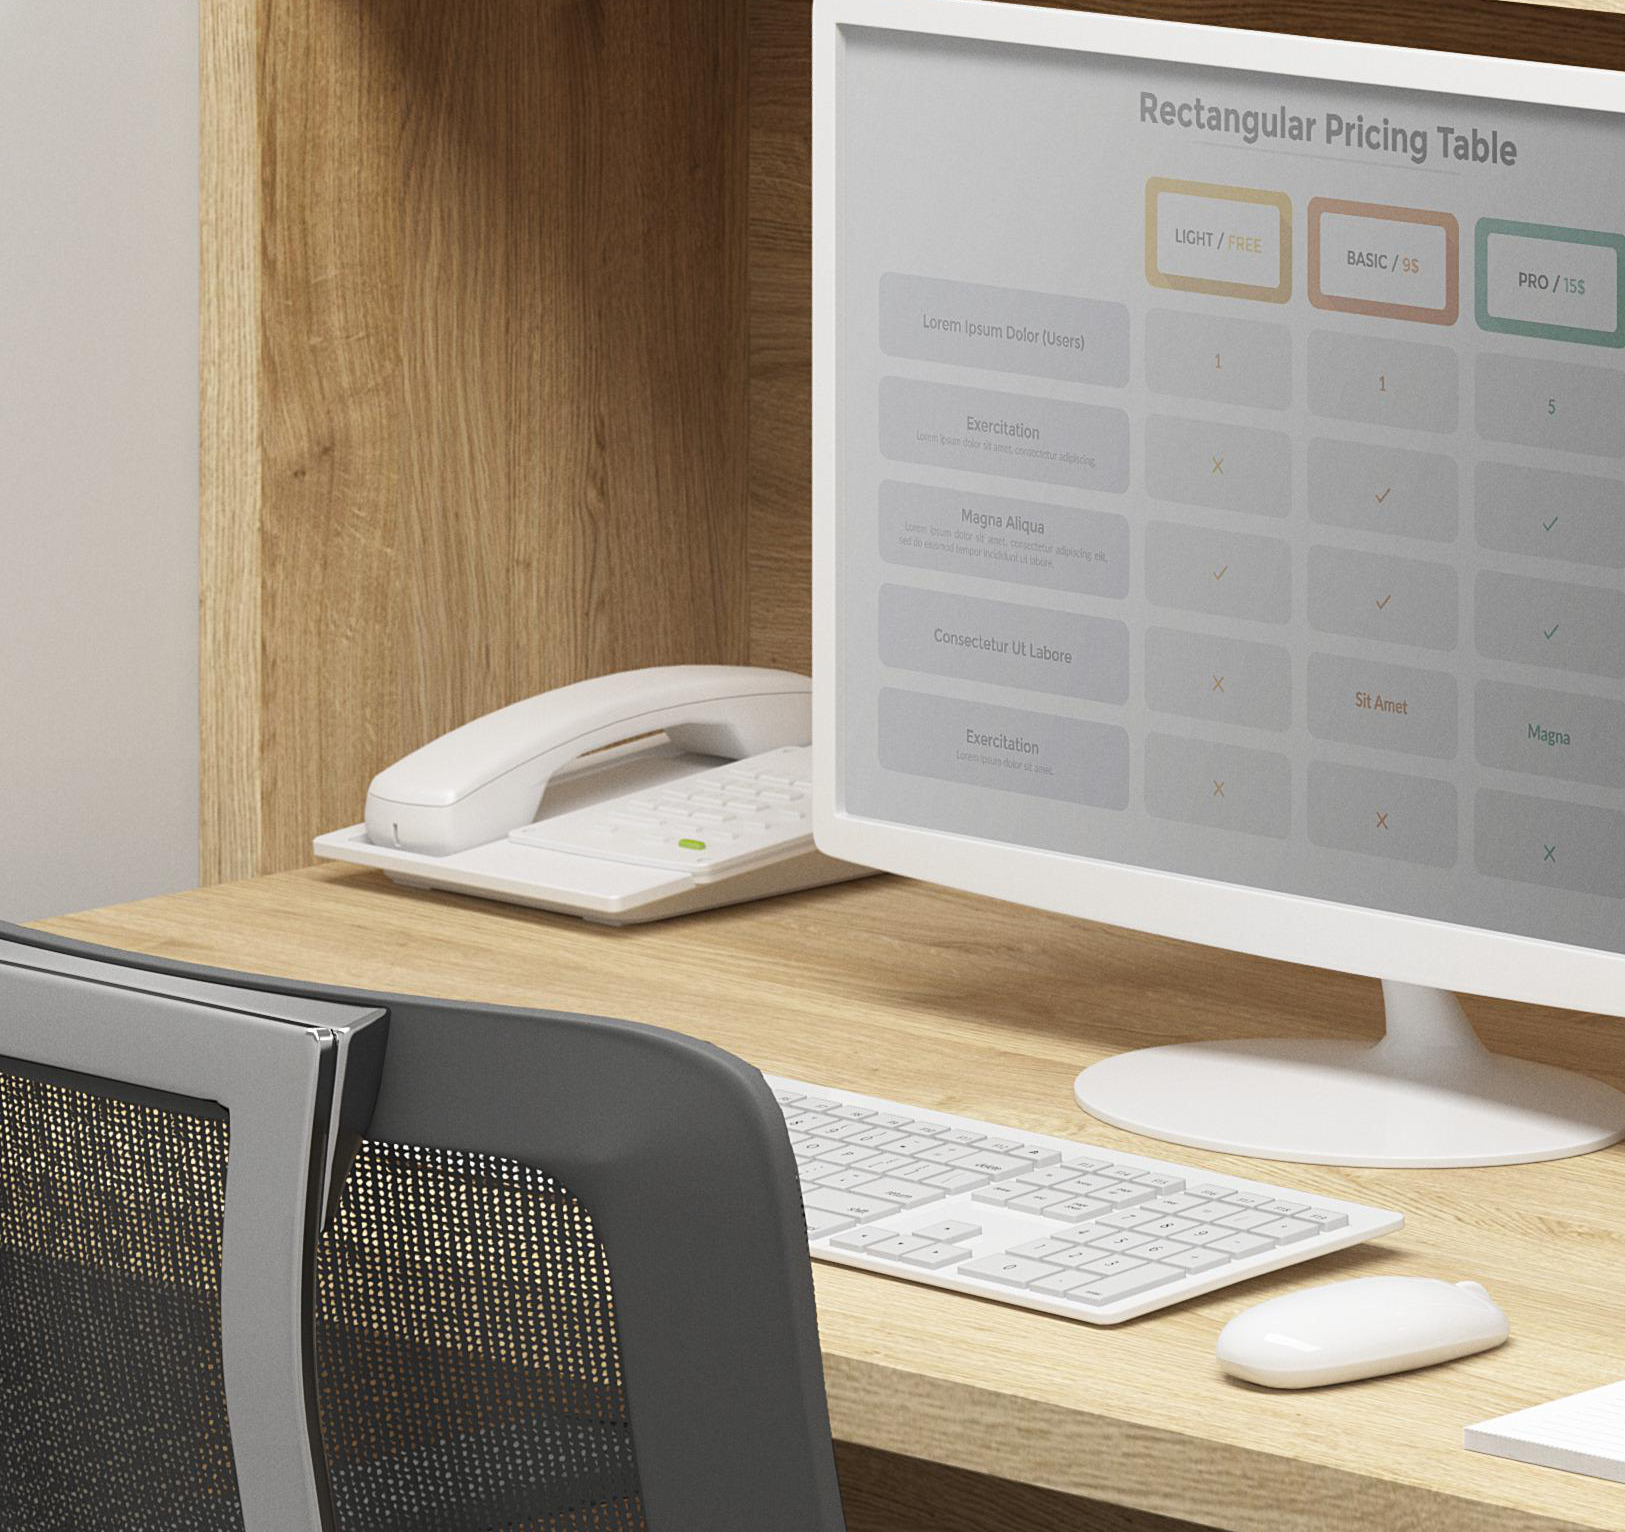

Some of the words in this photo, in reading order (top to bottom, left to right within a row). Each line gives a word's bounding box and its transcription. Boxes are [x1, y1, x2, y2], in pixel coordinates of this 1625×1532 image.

[1139, 91, 1316, 144] Rectangular
[1325, 113, 1428, 164] Pricing
[1437, 125, 1517, 167] Table
[1175, 227, 1213, 248] LIGHT
[1227, 233, 1263, 254] FREE
[1346, 249, 1388, 271] BASIC
[1402, 256, 1420, 275] 9$
[1518, 271, 1549, 292] PRO
[1563, 276, 1586, 296] 15$
[922, 313, 962, 333] Lorem
[964, 319, 1003, 342] Ipsum
[1006, 324, 1040, 345] Dolor
[1042, 328, 1086, 352] (Users)
[1214, 353, 1222, 370] 1
[1379, 375, 1387, 392] 1
[1548, 399, 1556, 416] 5
[966, 415, 1040, 441] Exercitation
[961, 507, 1002, 531] Magna
[1006, 514, 1045, 536] Aliqua
[933, 628, 1009, 654] Consectetur
[1012, 640, 1027, 656] Ut
[1029, 643, 1072, 664] Labore
[1355, 691, 1372, 709] Sit
[1374, 695, 1409, 716] Amet
[966, 728, 1040, 756] Exercitation
[1527, 724, 1571, 747] Magna
